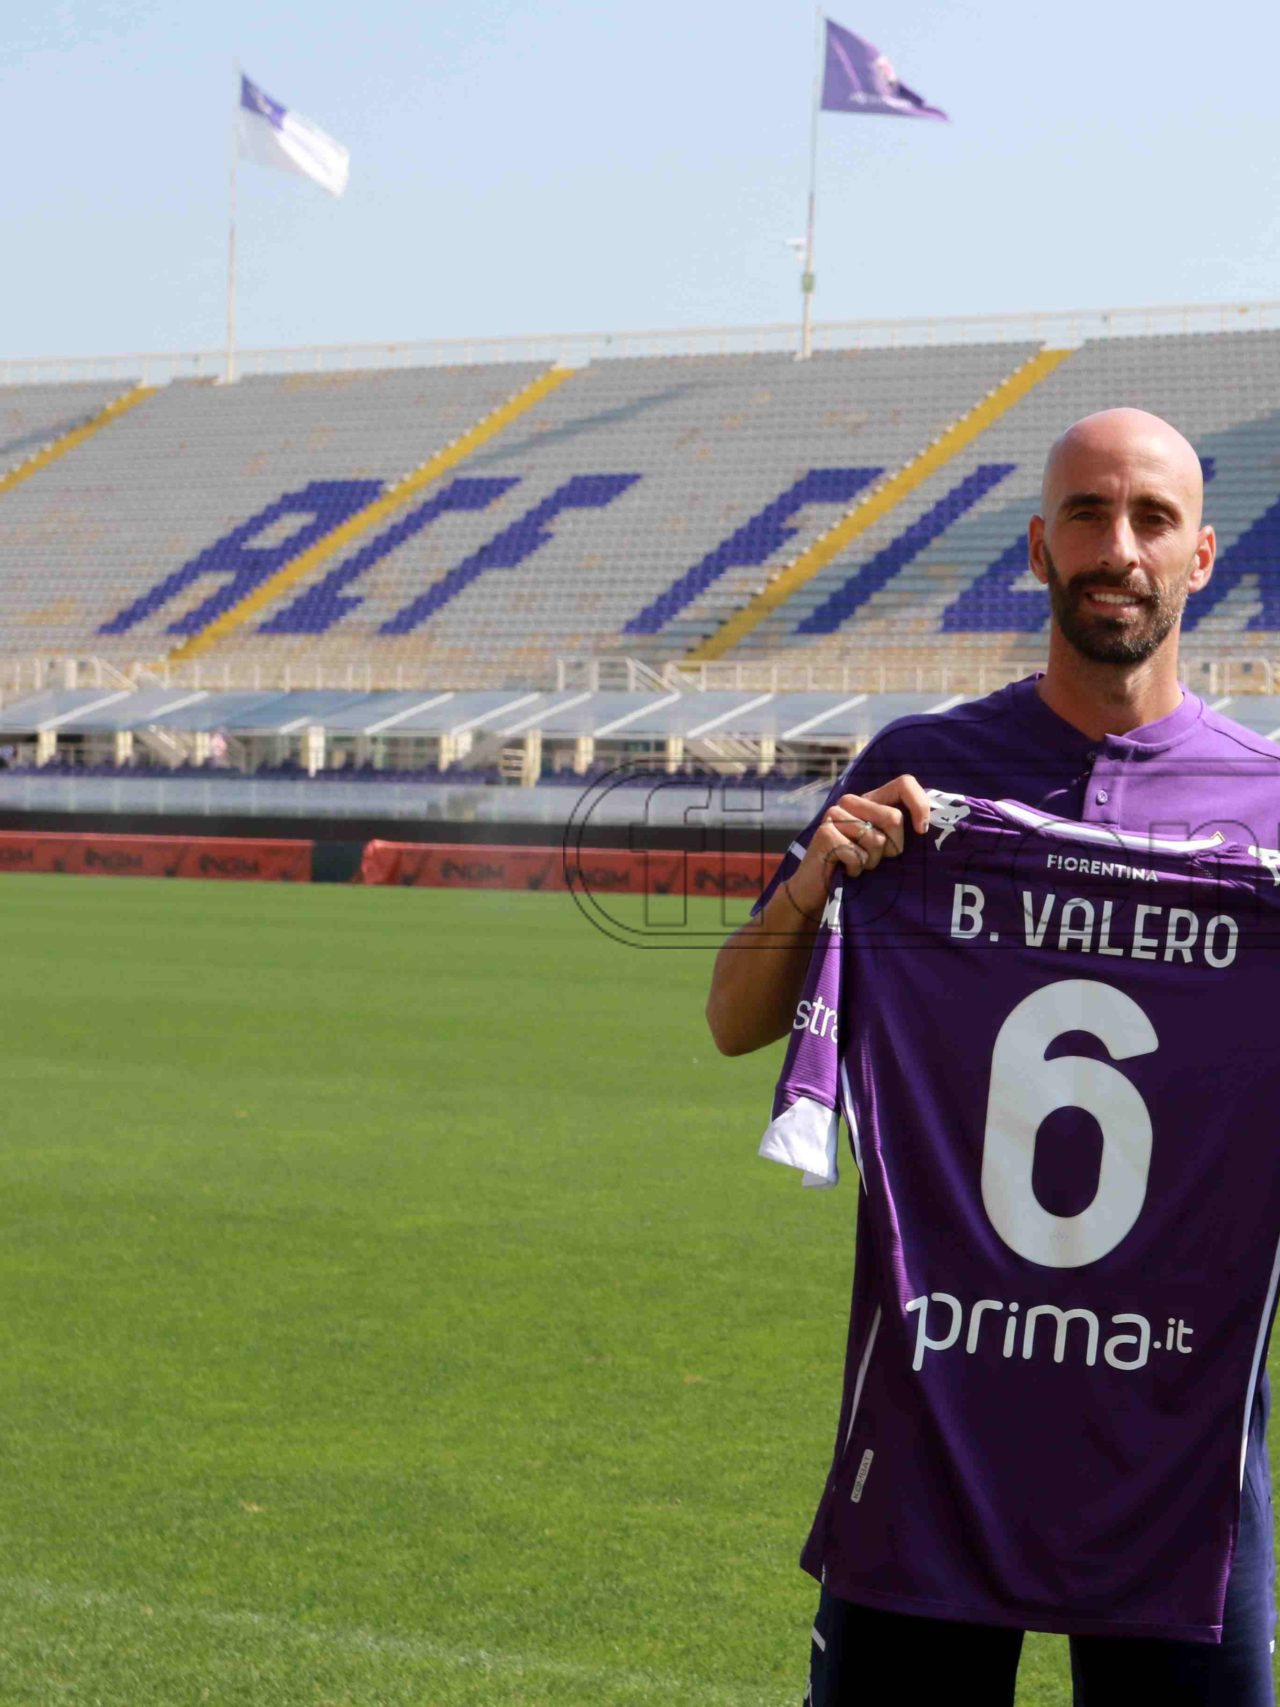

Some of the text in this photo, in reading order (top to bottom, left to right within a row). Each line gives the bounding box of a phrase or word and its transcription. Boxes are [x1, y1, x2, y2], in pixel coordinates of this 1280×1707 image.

[97, 472, 643, 634] ACF
[1046, 853, 1158, 882] FIORENTINA
[950, 883, 1239, 969] B. VALERO
[981, 978, 1160, 1268] 6
[905, 1292, 1194, 1371] prima.it
